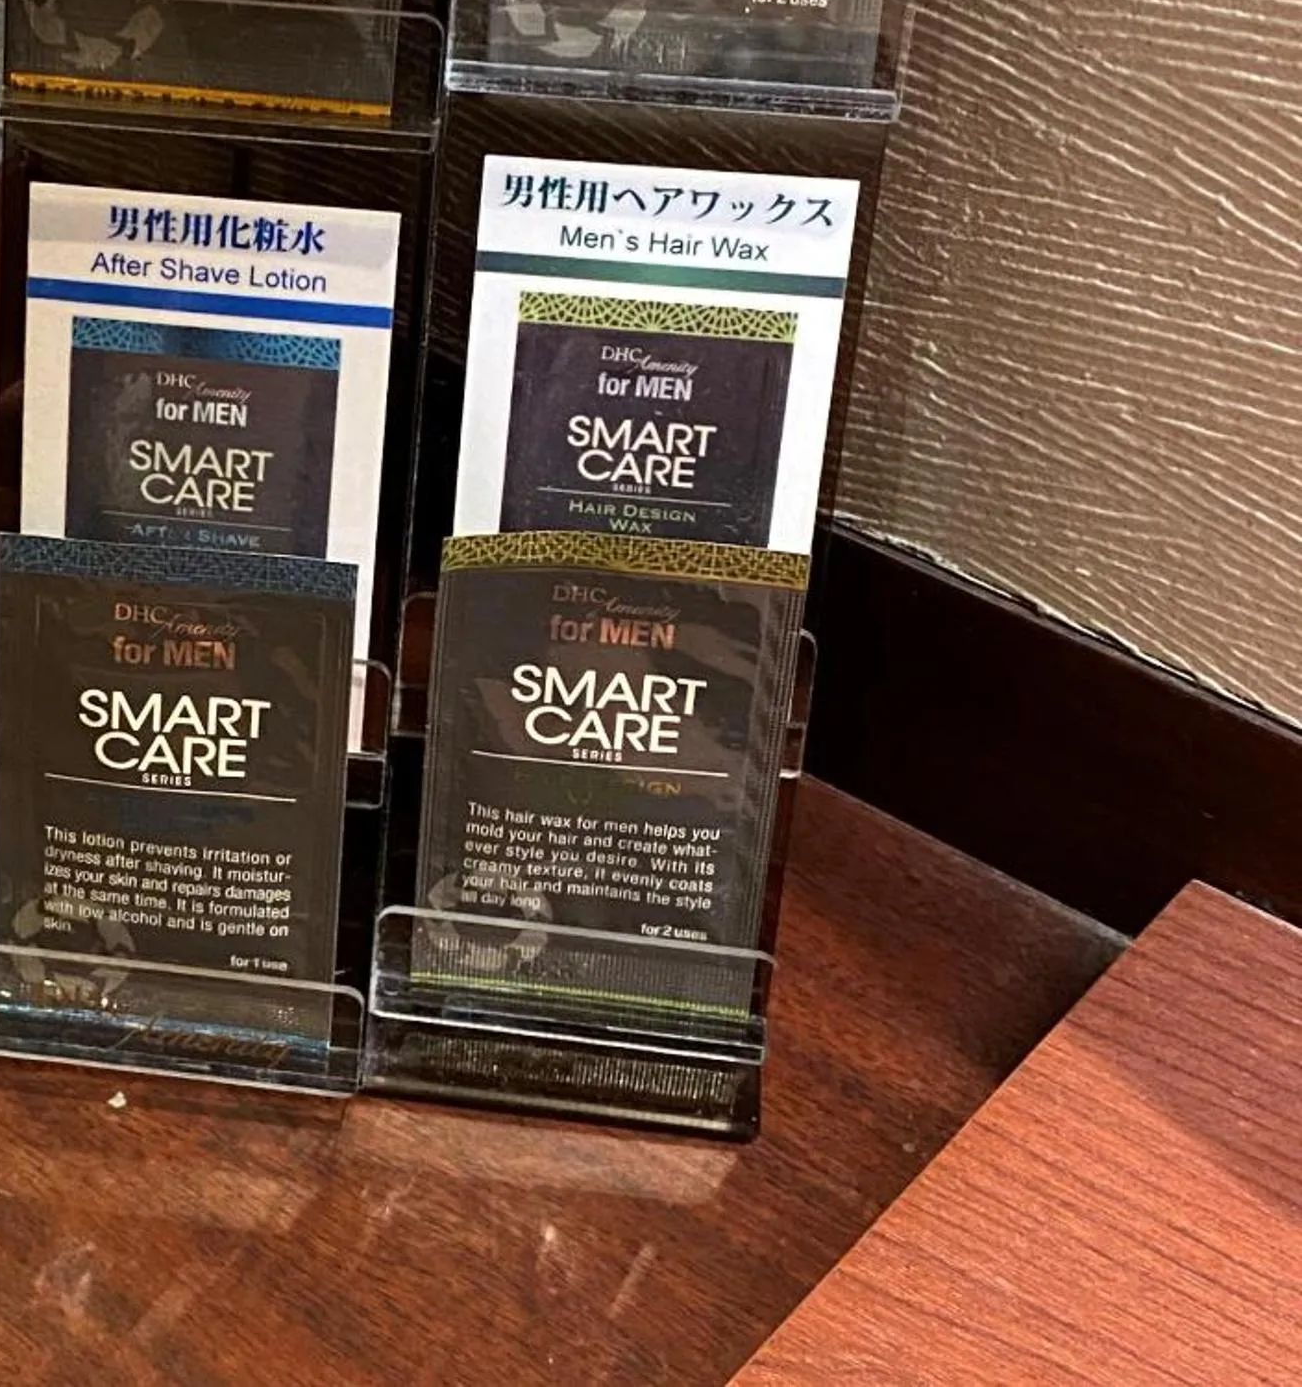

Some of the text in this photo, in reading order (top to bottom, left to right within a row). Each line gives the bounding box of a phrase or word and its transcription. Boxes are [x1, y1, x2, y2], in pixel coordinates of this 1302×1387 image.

[502, 173, 834, 227] 男性用ヘアワックス
[108, 205, 326, 255] 男性用化粧水
[649, 232, 702, 257] Hair
[711, 238, 770, 262] Wax
[91, 252, 326, 293] After Shave Lotion
[598, 371, 693, 401] for MEN
[156, 397, 247, 428] for MEN
[567, 415, 717, 458] SMART
[130, 440, 274, 481] SMART
[577, 450, 696, 489] CARE
[140, 473, 255, 512] CARE
[550, 614, 675, 649] for MEN
[112, 636, 235, 670] for MEN
[511, 663, 707, 715] SMART
[79, 688, 271, 739] SMART
[525, 705, 681, 753] CARE
[95, 731, 247, 778] CARE
[468, 802, 720, 842] This hair wax for men helps you
[45, 826, 291, 865] This lotion prevents irritation or
